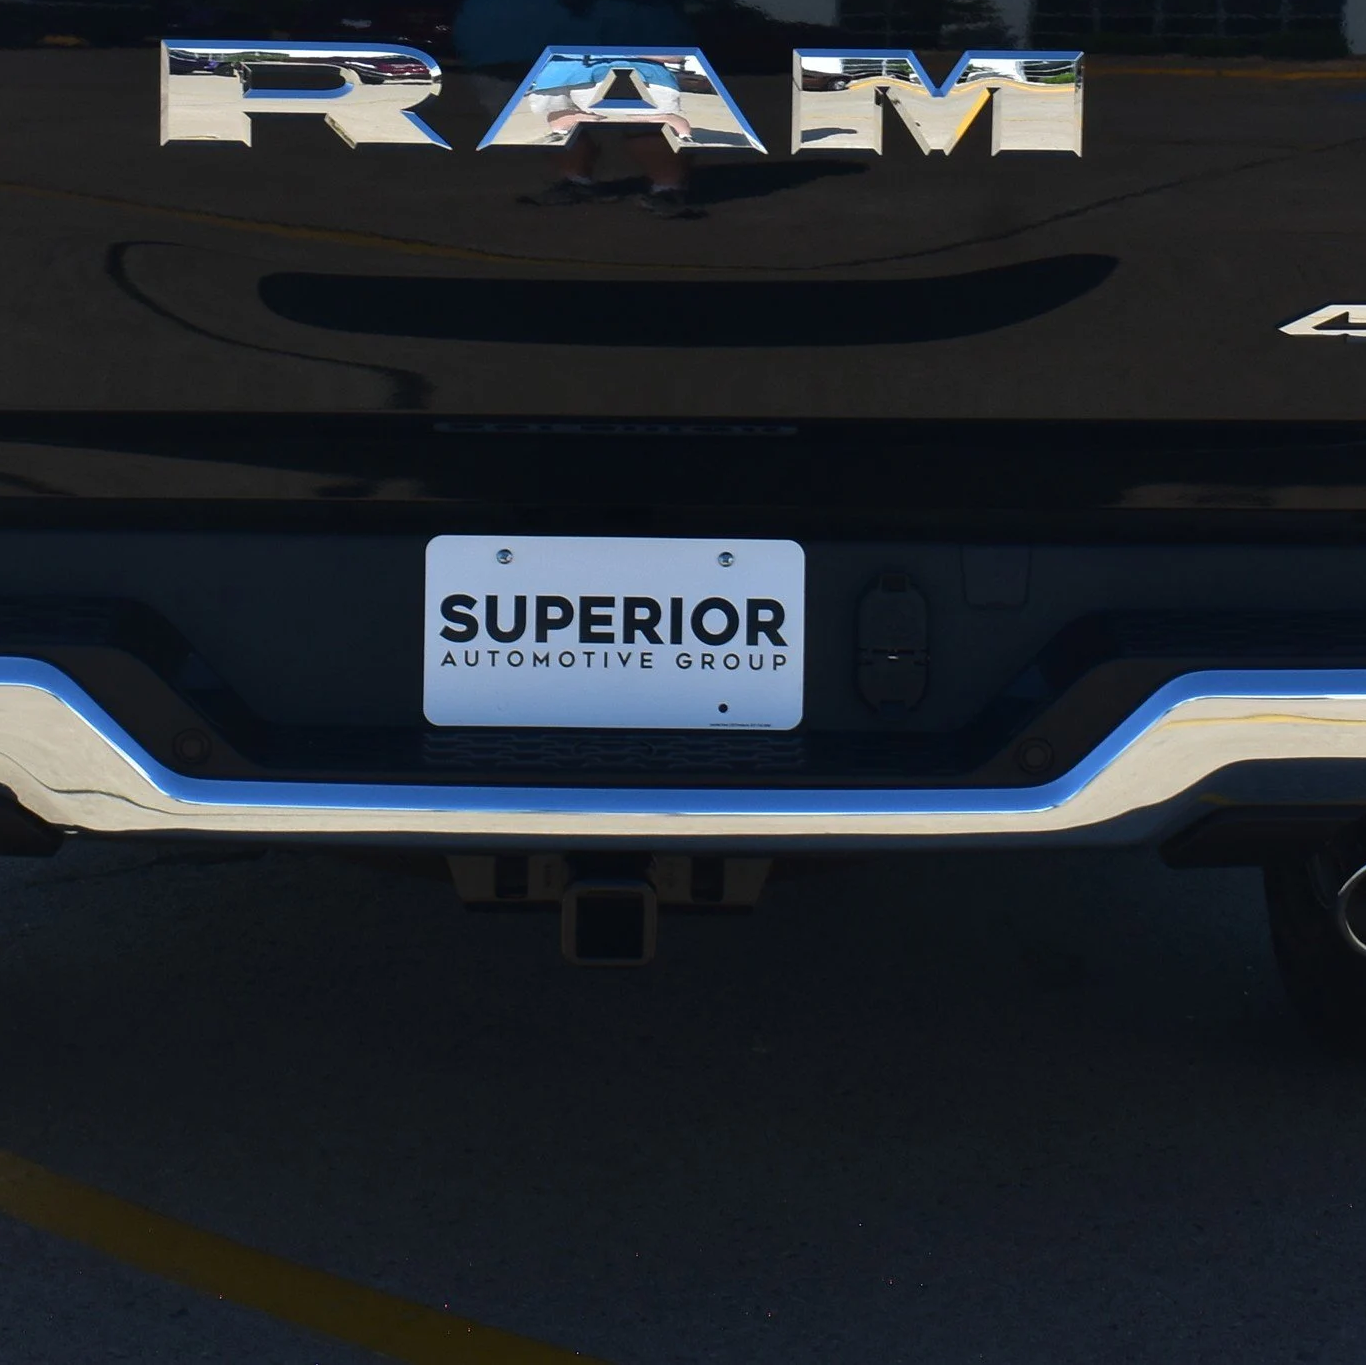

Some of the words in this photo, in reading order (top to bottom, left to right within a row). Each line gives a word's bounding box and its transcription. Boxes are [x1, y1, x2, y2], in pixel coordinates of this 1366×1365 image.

[160, 39, 1086, 158] RAM
[438, 594, 789, 648] SUPERIOR
[440, 650, 655, 670] AUTOMOTIVE
[675, 652, 788, 671] GROUP
